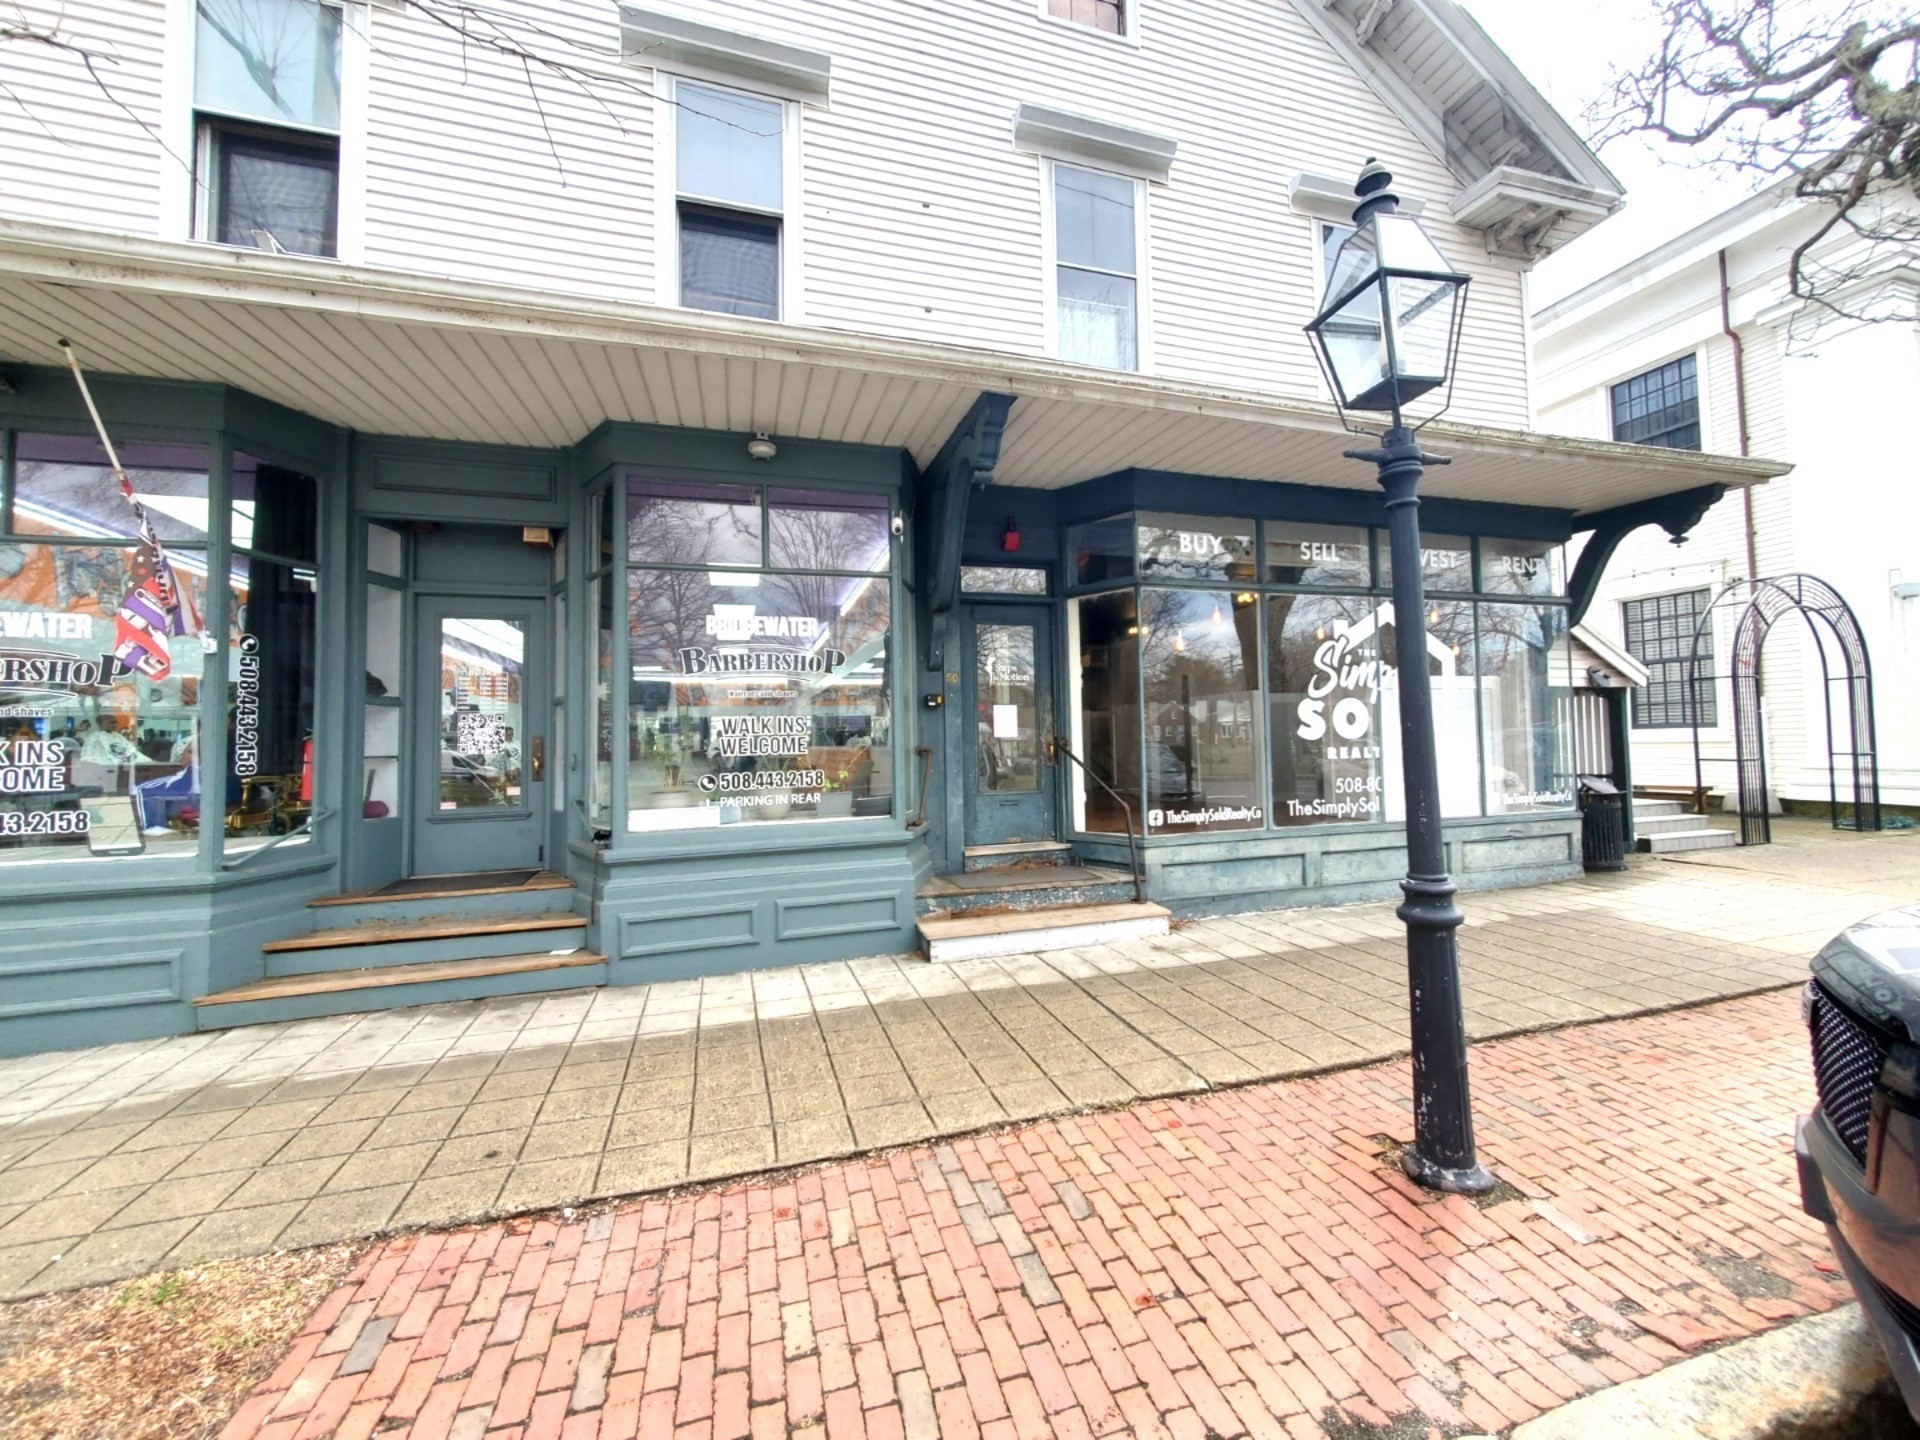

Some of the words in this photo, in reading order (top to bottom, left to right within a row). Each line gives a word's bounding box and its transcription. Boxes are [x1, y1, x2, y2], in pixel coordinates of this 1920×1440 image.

[1179, 533, 1223, 554] BUY
[1300, 542, 1340, 562] SELL
[1419, 551, 1457, 569] VEST
[1501, 556, 1543, 573] RENT
[0, 653, 135, 687] RSHOP
[678, 646, 847, 678] BARBERSHOP
[1307, 633, 1399, 705] Simp
[946, 672, 958, 684] 50
[1000, 672, 1030, 681] Motion
[13, 704, 54, 717] shaves
[235, 655, 260, 776] 508.443.2158
[1297, 697, 1369, 741] SO
[721, 716, 773, 737] WALK
[777, 715, 808, 736] INS
[14, 741, 65, 766] INS
[720, 736, 808, 757] WELCOME
[1326, 746, 1380, 760] REALT
[0, 766, 66, 792] OME
[719, 769, 825, 791] 508.443.2158
[720, 795, 773, 808] PARKING
[775, 794, 788, 805] IN
[790, 793, 822, 805] REAR
[1166, 806, 1262, 825] TheSimplySoldRealtyCo
